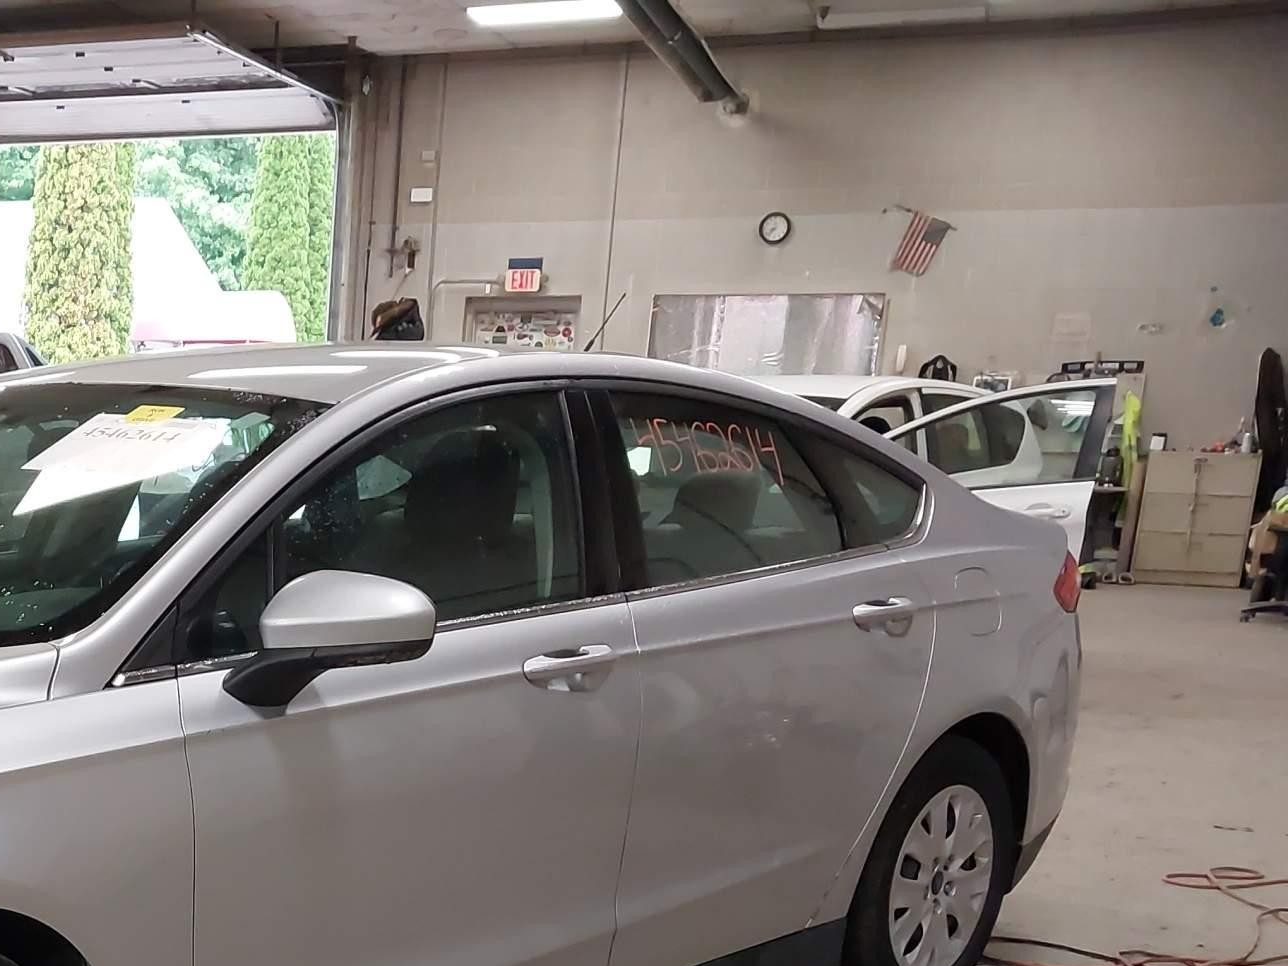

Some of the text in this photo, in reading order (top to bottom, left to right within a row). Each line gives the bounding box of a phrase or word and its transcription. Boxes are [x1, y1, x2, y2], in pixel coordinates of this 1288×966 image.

[511, 270, 537, 290] EXIT
[83, 426, 181, 442] 45462614
[629, 417, 785, 487] 45462614
